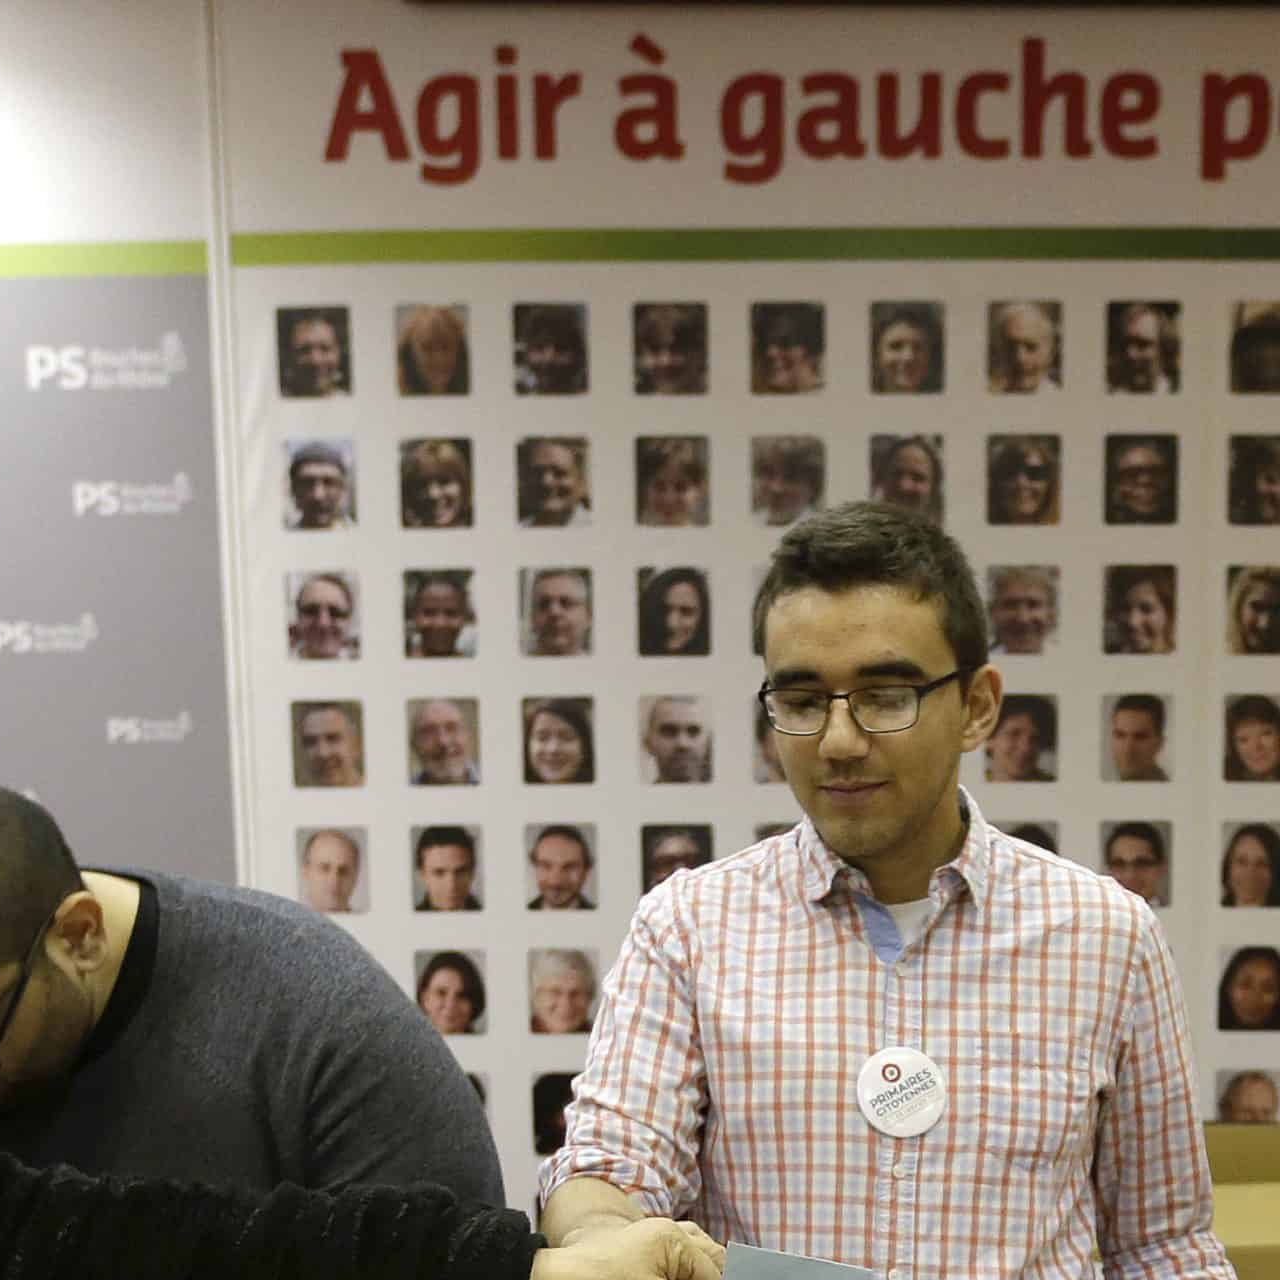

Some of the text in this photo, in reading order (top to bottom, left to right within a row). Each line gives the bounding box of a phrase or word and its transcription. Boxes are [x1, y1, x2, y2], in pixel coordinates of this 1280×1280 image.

[324, 34, 1280, 185] Agir à gauche p
[26, 346, 88, 390] PS
[73, 481, 120, 516] PS
[870, 1068, 932, 1108] PRIMAIRES
[875, 1079, 937, 1117] CITOYENNES
